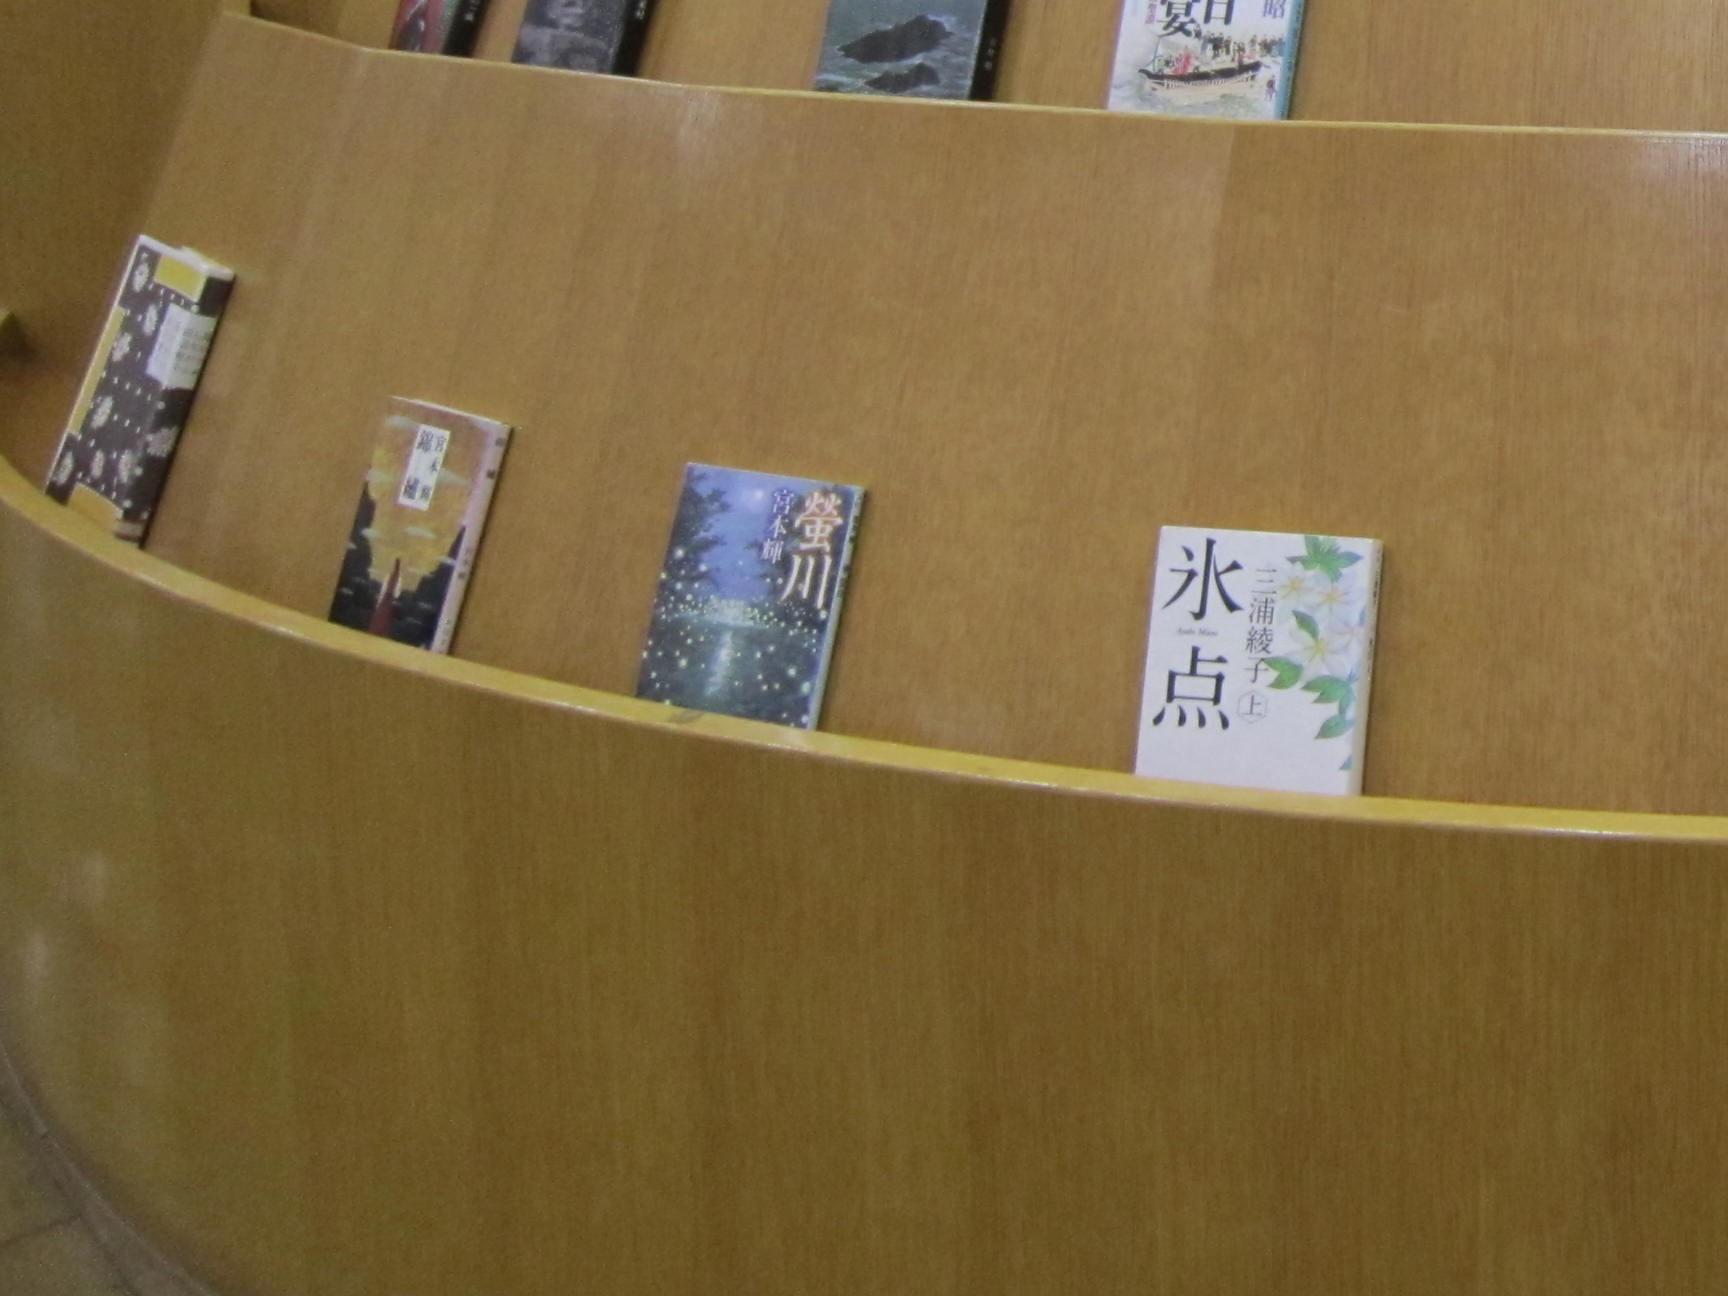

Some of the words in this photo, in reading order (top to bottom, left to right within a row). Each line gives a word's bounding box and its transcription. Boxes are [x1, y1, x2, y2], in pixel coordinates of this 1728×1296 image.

[760, 489, 795, 564] 宮本輝
[1152, 537, 1245, 731] 氷点
[1244, 567, 1277, 684] 三浦綾子
